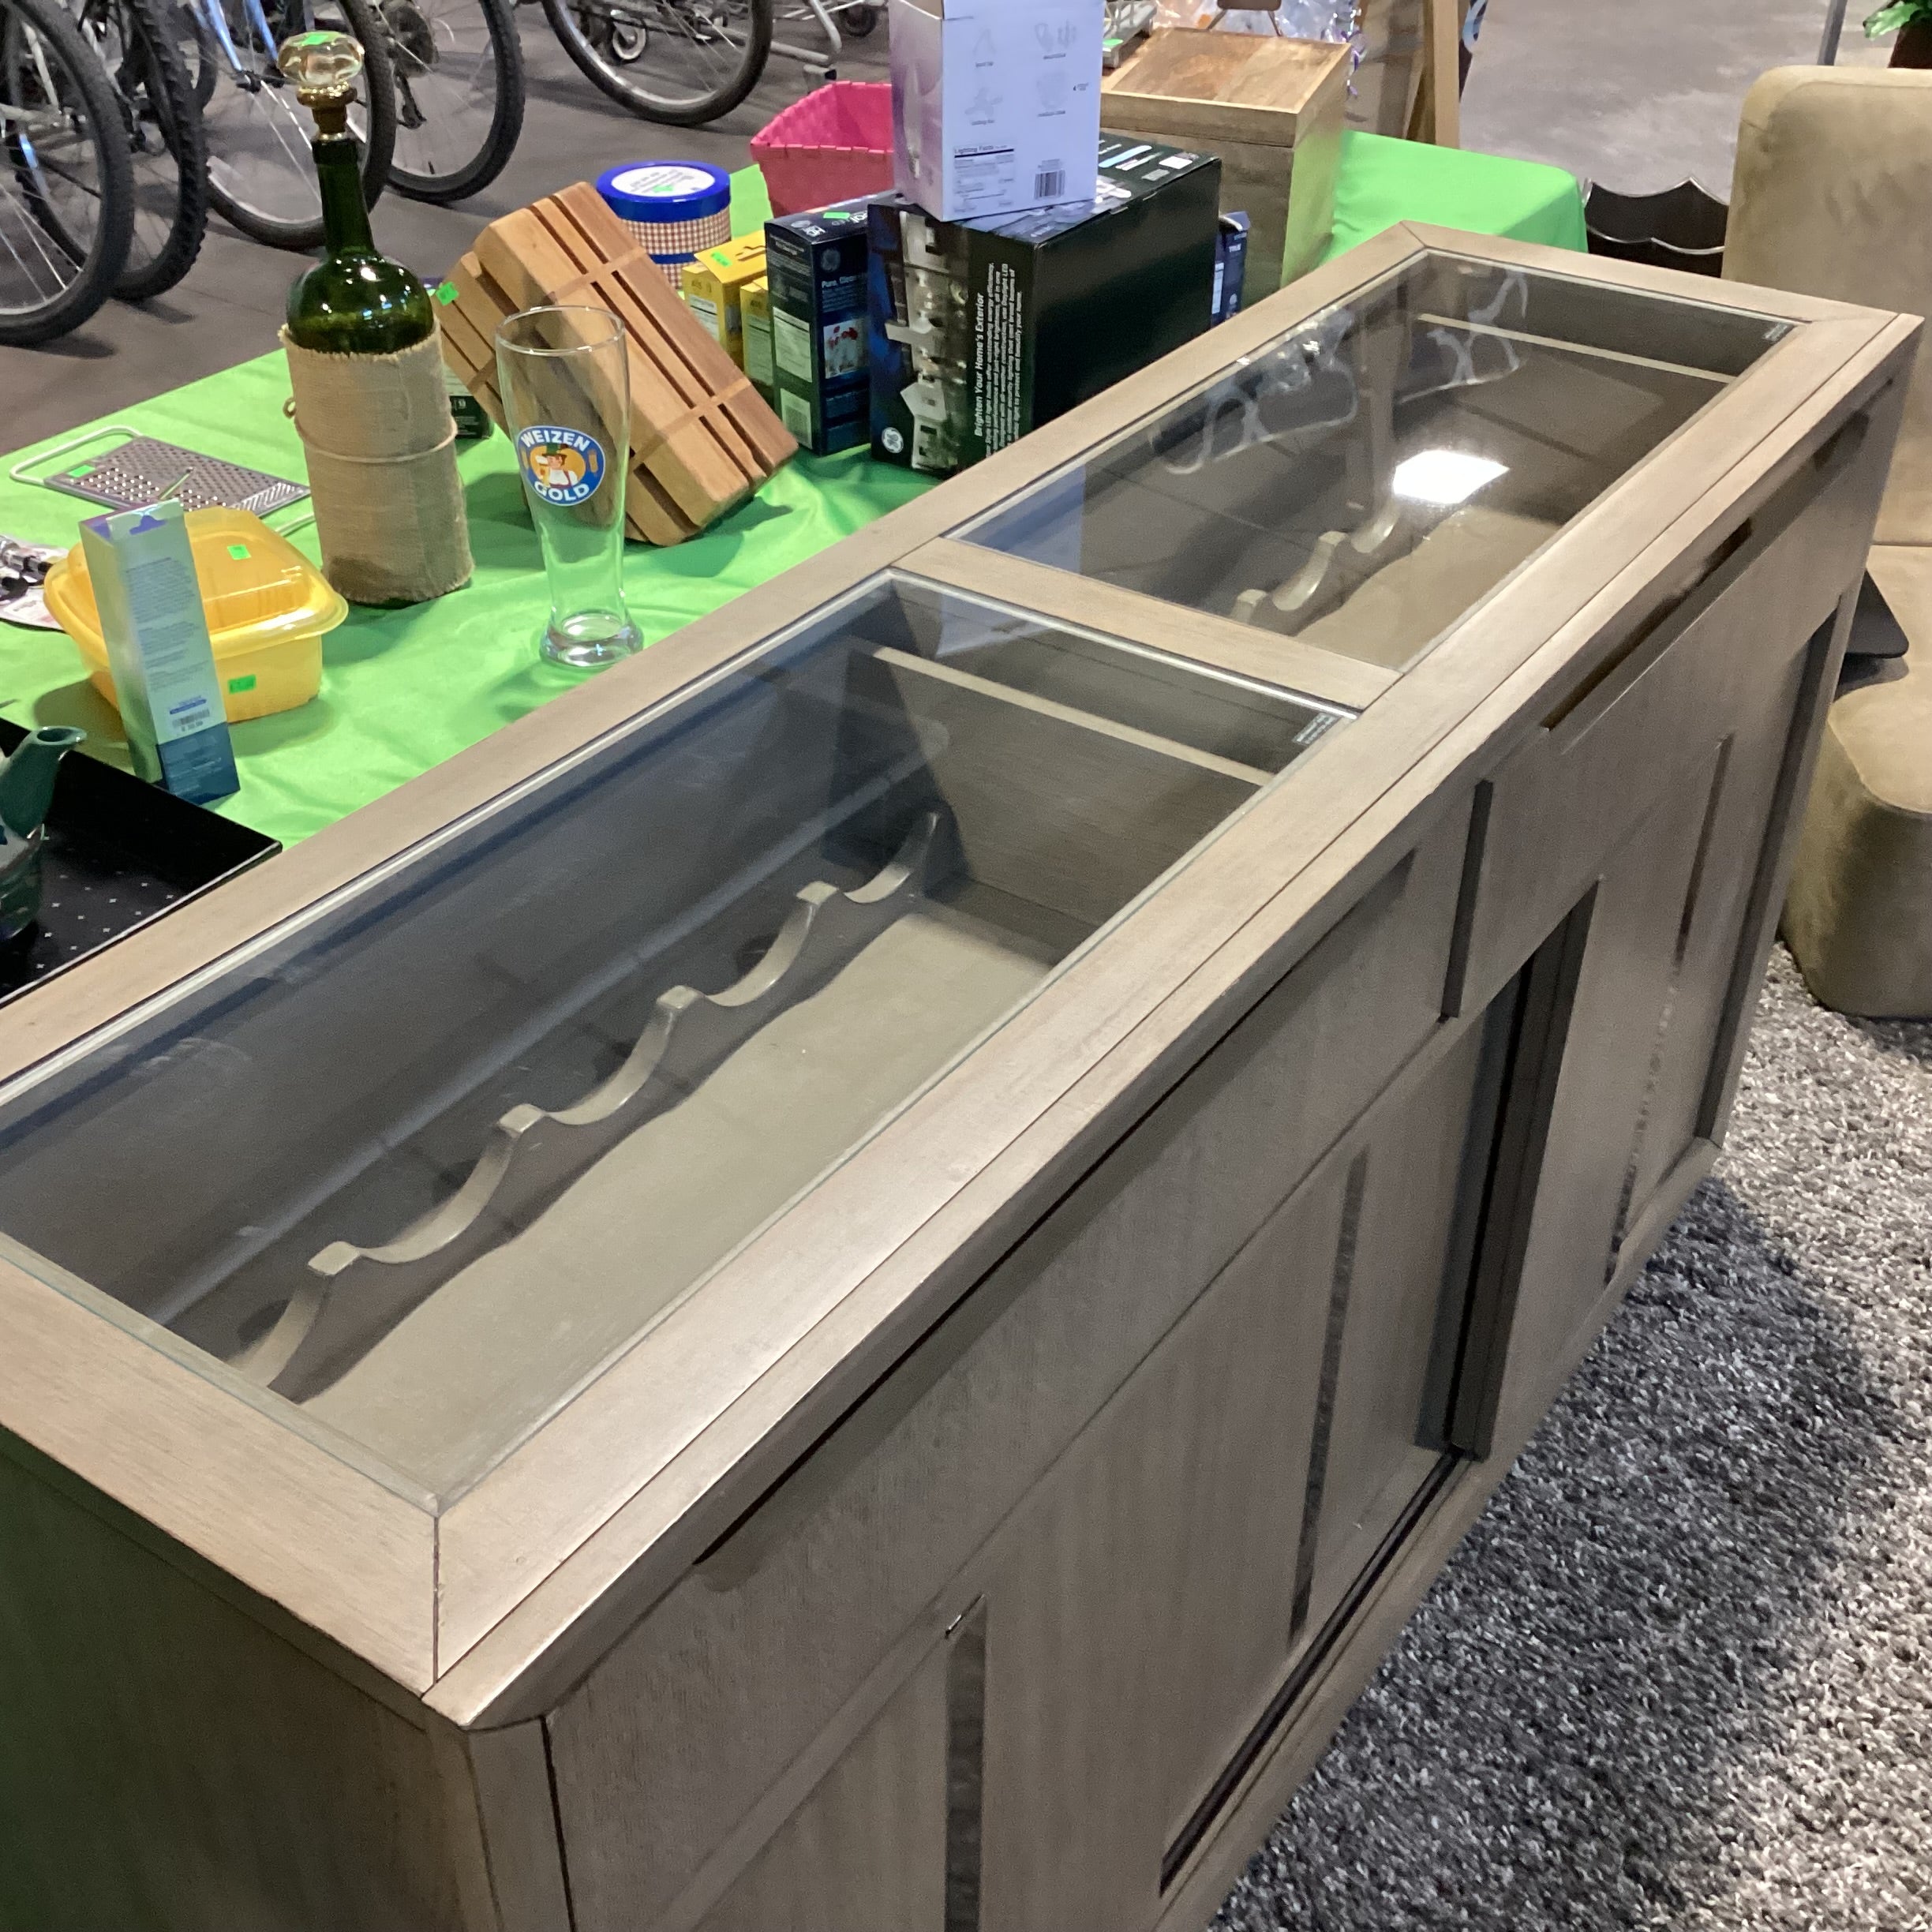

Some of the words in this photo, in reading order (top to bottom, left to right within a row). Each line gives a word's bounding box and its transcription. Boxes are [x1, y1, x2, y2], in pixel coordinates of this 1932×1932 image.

[975, 292, 984, 331] Exterior
[975, 334, 984, 369] Home's
[975, 372, 983, 394] Your
[974, 396, 984, 436] Brighten
[521, 429, 590, 452] WEIZEN
[534, 481, 590, 501] GOLD
